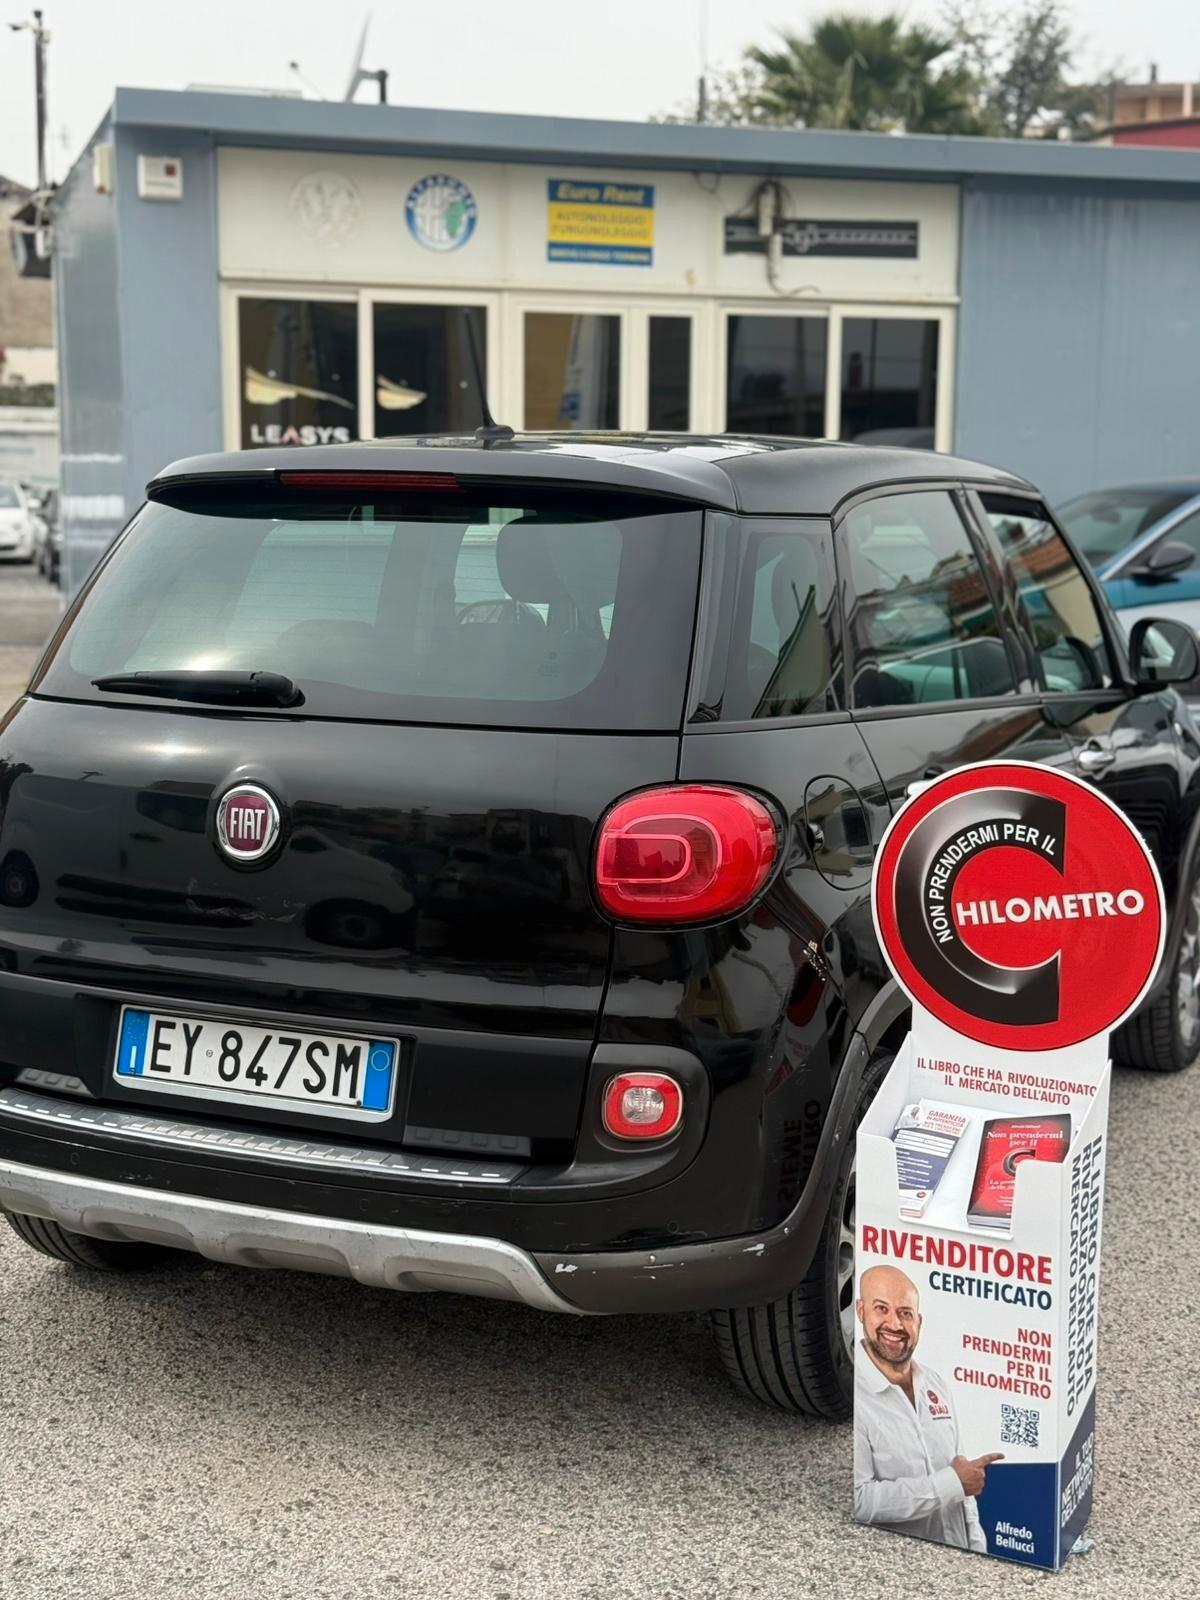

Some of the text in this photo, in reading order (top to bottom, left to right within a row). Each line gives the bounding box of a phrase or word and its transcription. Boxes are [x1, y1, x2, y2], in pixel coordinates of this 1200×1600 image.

[558, 182, 600, 201] Euro
[251, 424, 350, 446] LEASYS
[230, 807, 266, 840] FIAT
[929, 823, 1057, 943] NON PRENDERMI PER IL
[917, 1057, 927, 1069] IL
[929, 1059, 961, 1074] LIBRO
[963, 1065, 984, 1079] CHE
[987, 1069, 1003, 1081] HA
[944, 1075, 1071, 1106] IL MERCATO DELL'AUTO
[928, 1110, 966, 1123] GARANZIA
[987, 1131, 1064, 1140] Non prendermi
[1070, 1153, 1081, 1278] MERCATO
[862, 1225, 1052, 1284] RIVENDITORE
[1084, 1135, 1102, 1389] IL LIBRO CHE HA
[1076, 1142, 1092, 1404] RIVOLUZIONATO IL
[929, 1271, 1052, 1310] CERTIFICATO
[962, 1334, 1051, 1365] PRENDERMI
[1018, 1328, 1051, 1348] NON
[954, 1366, 1051, 1399] CHILOMETRO
[1007, 1360, 1052, 1383] PER IL
[995, 1521, 1033, 1540] Alfredo
[996, 1534, 1034, 1554] Bellucci
